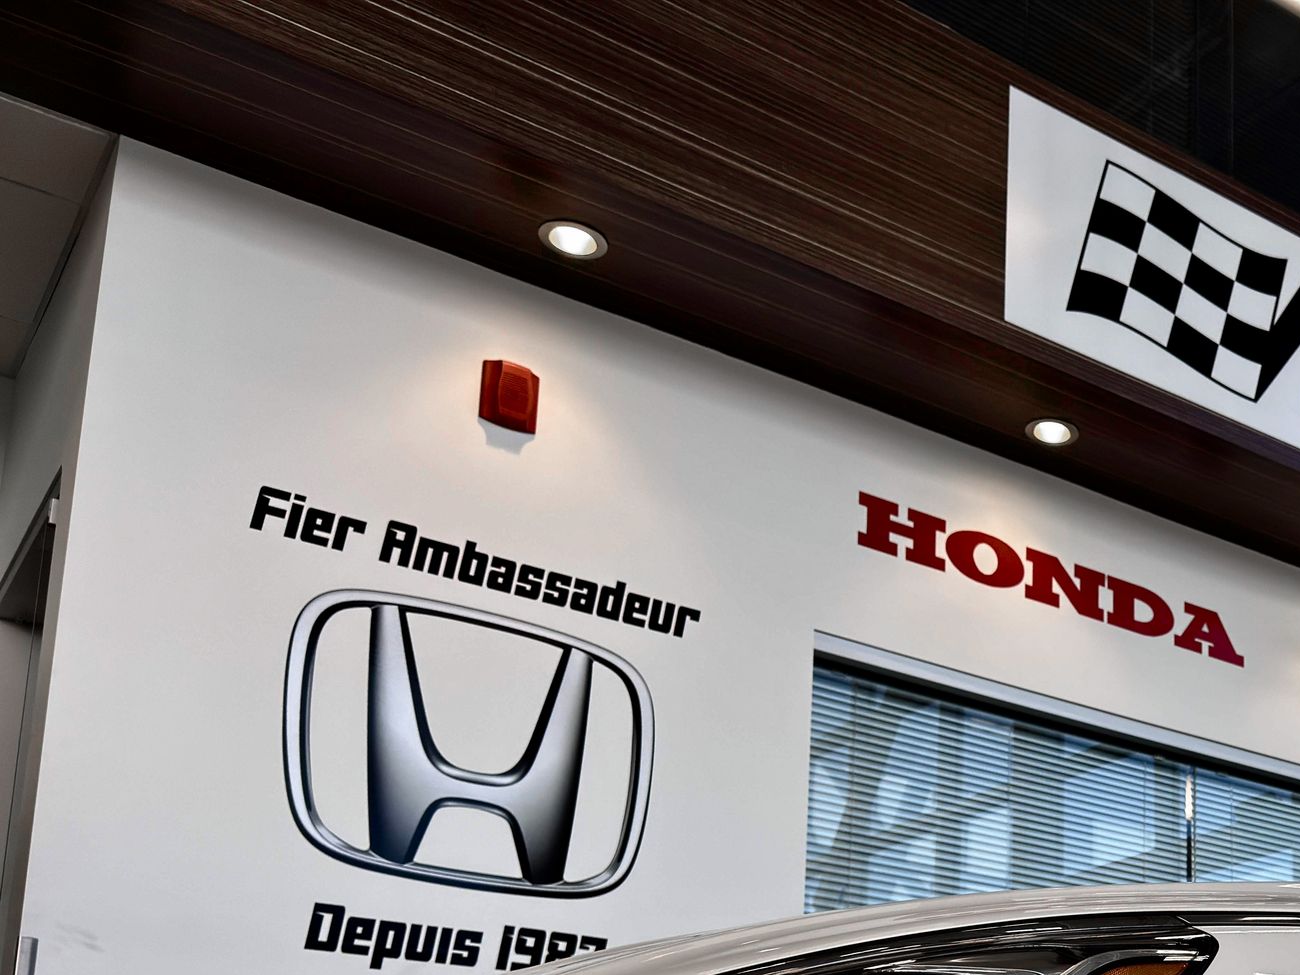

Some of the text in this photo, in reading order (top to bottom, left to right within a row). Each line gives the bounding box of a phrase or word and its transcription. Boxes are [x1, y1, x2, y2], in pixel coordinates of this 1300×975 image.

[249, 485, 701, 638] Fier Ambassadeur
[857, 491, 1245, 667] HONDA
[303, 902, 484, 970] Depuis
